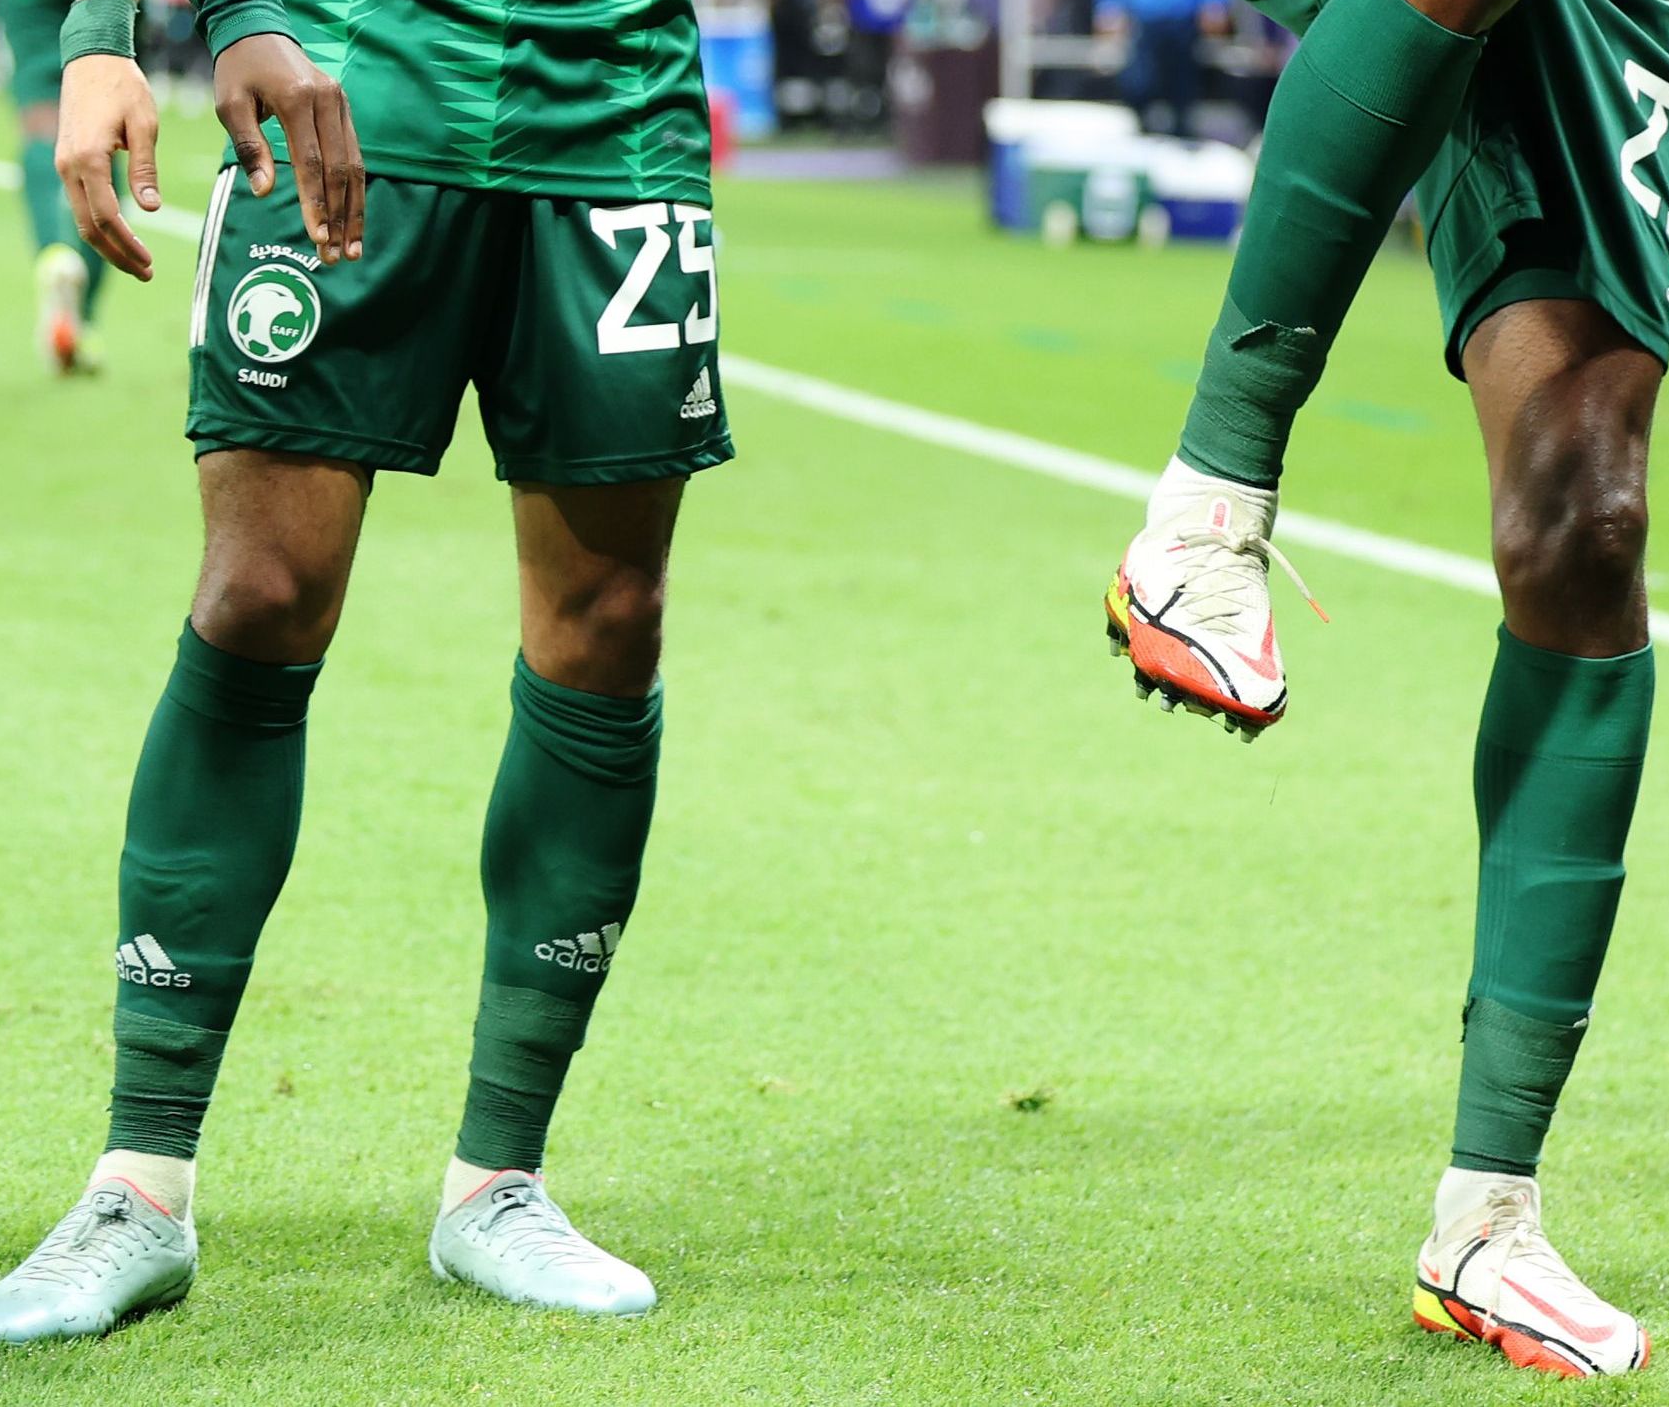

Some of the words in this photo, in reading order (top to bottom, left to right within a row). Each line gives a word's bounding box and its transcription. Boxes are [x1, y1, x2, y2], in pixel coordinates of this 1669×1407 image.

[248, 243, 322, 272] السعودية
[589, 201, 718, 355] 25
[271, 325, 300, 338] SAFF
[237, 368, 288, 389] SAUDI
